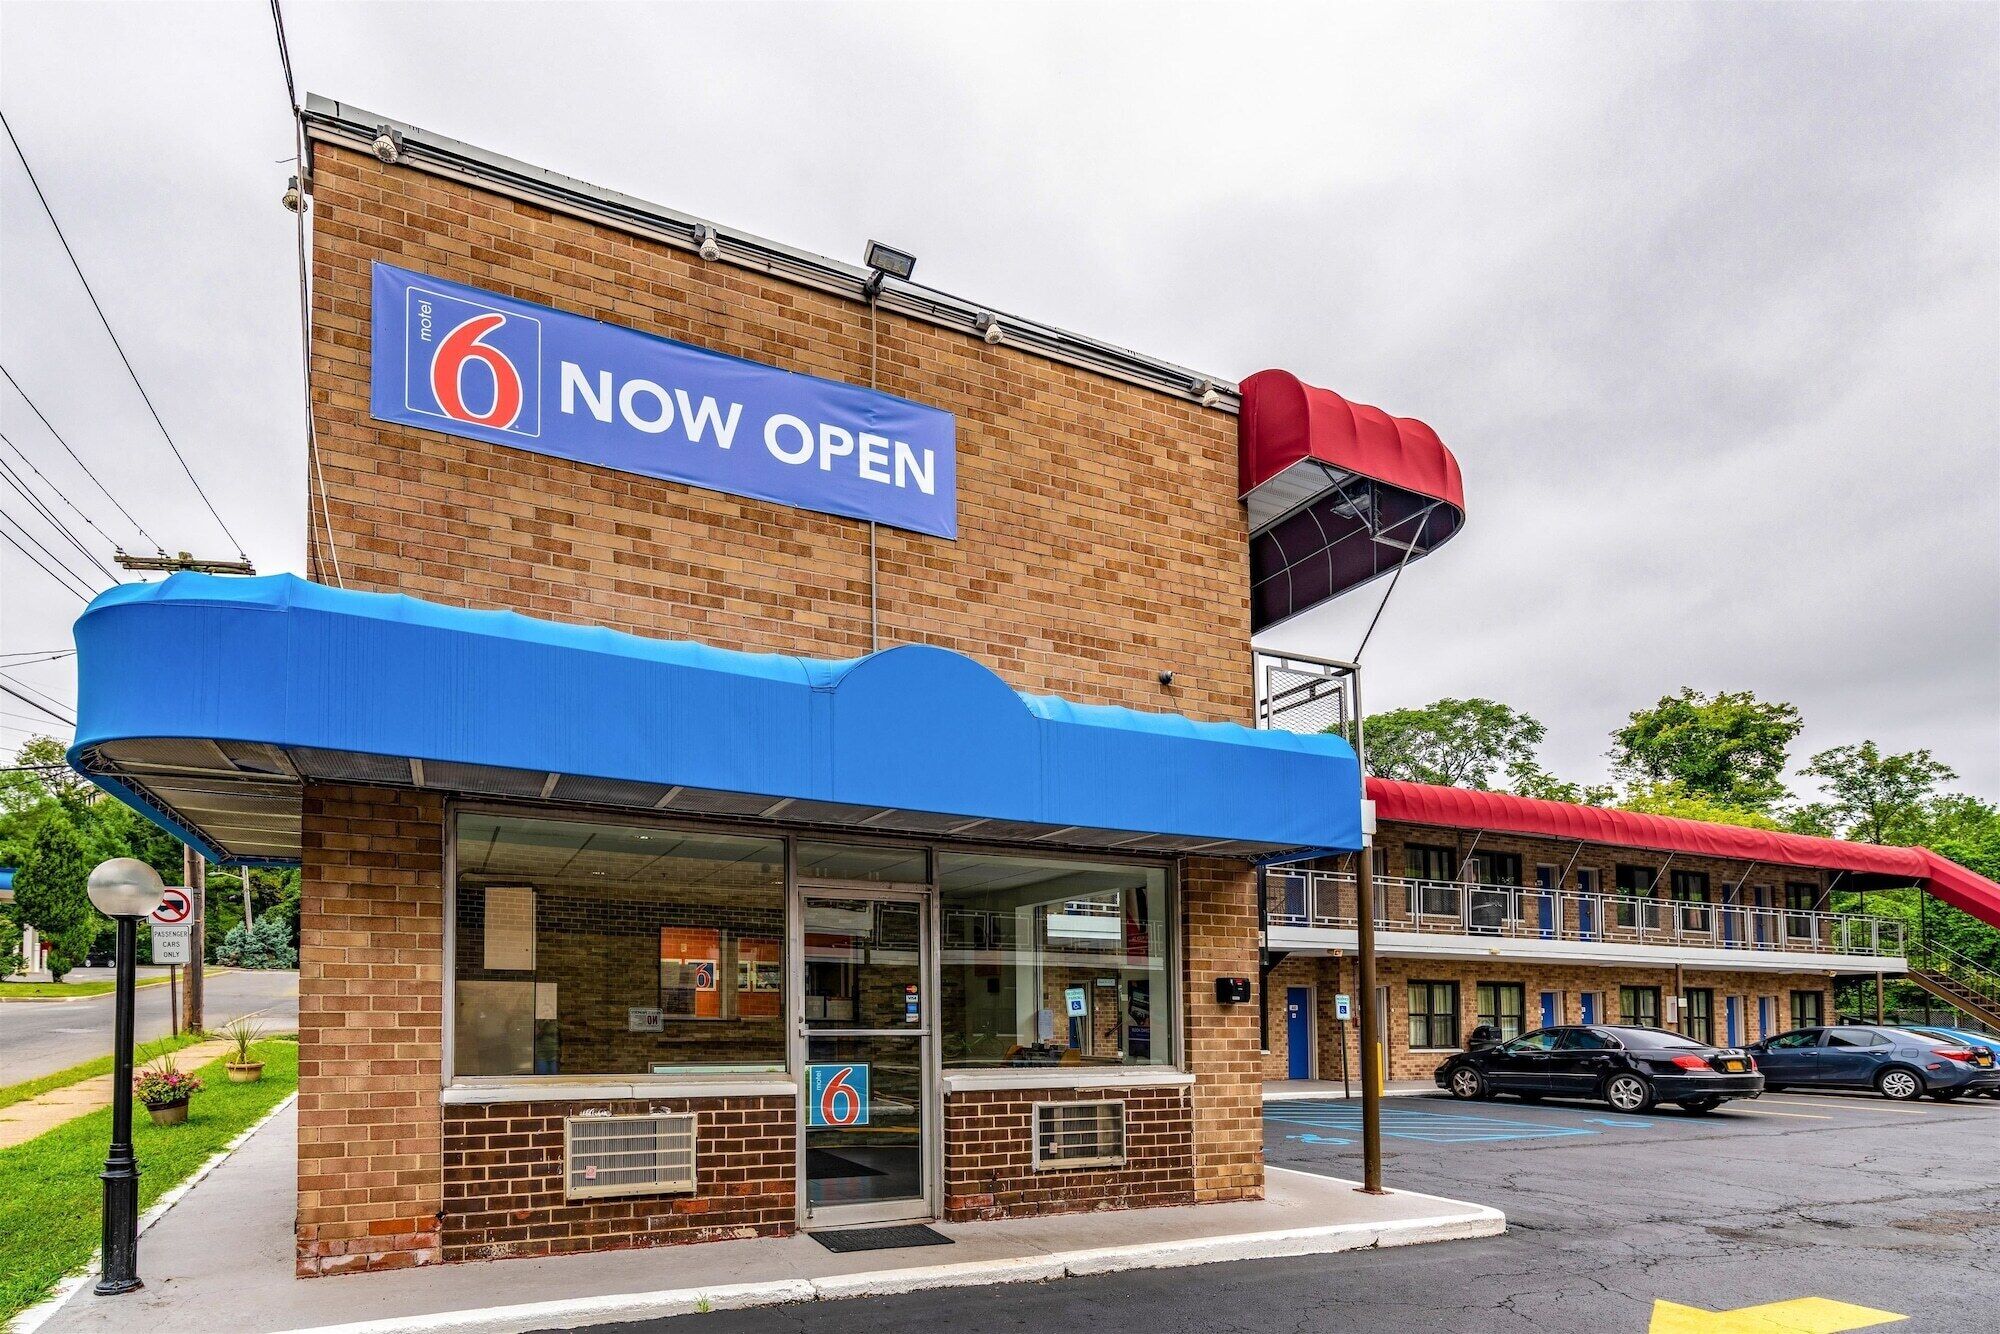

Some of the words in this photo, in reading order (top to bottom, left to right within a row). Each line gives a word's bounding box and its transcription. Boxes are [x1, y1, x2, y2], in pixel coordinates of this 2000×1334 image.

[418, 300, 432, 342] motel
[430, 312, 523, 430] 6
[561, 361, 743, 449] NOW
[763, 413, 935, 495] OPEN
[154, 930, 188, 938] PASSENGER
[821, 1067, 860, 1125] 6
